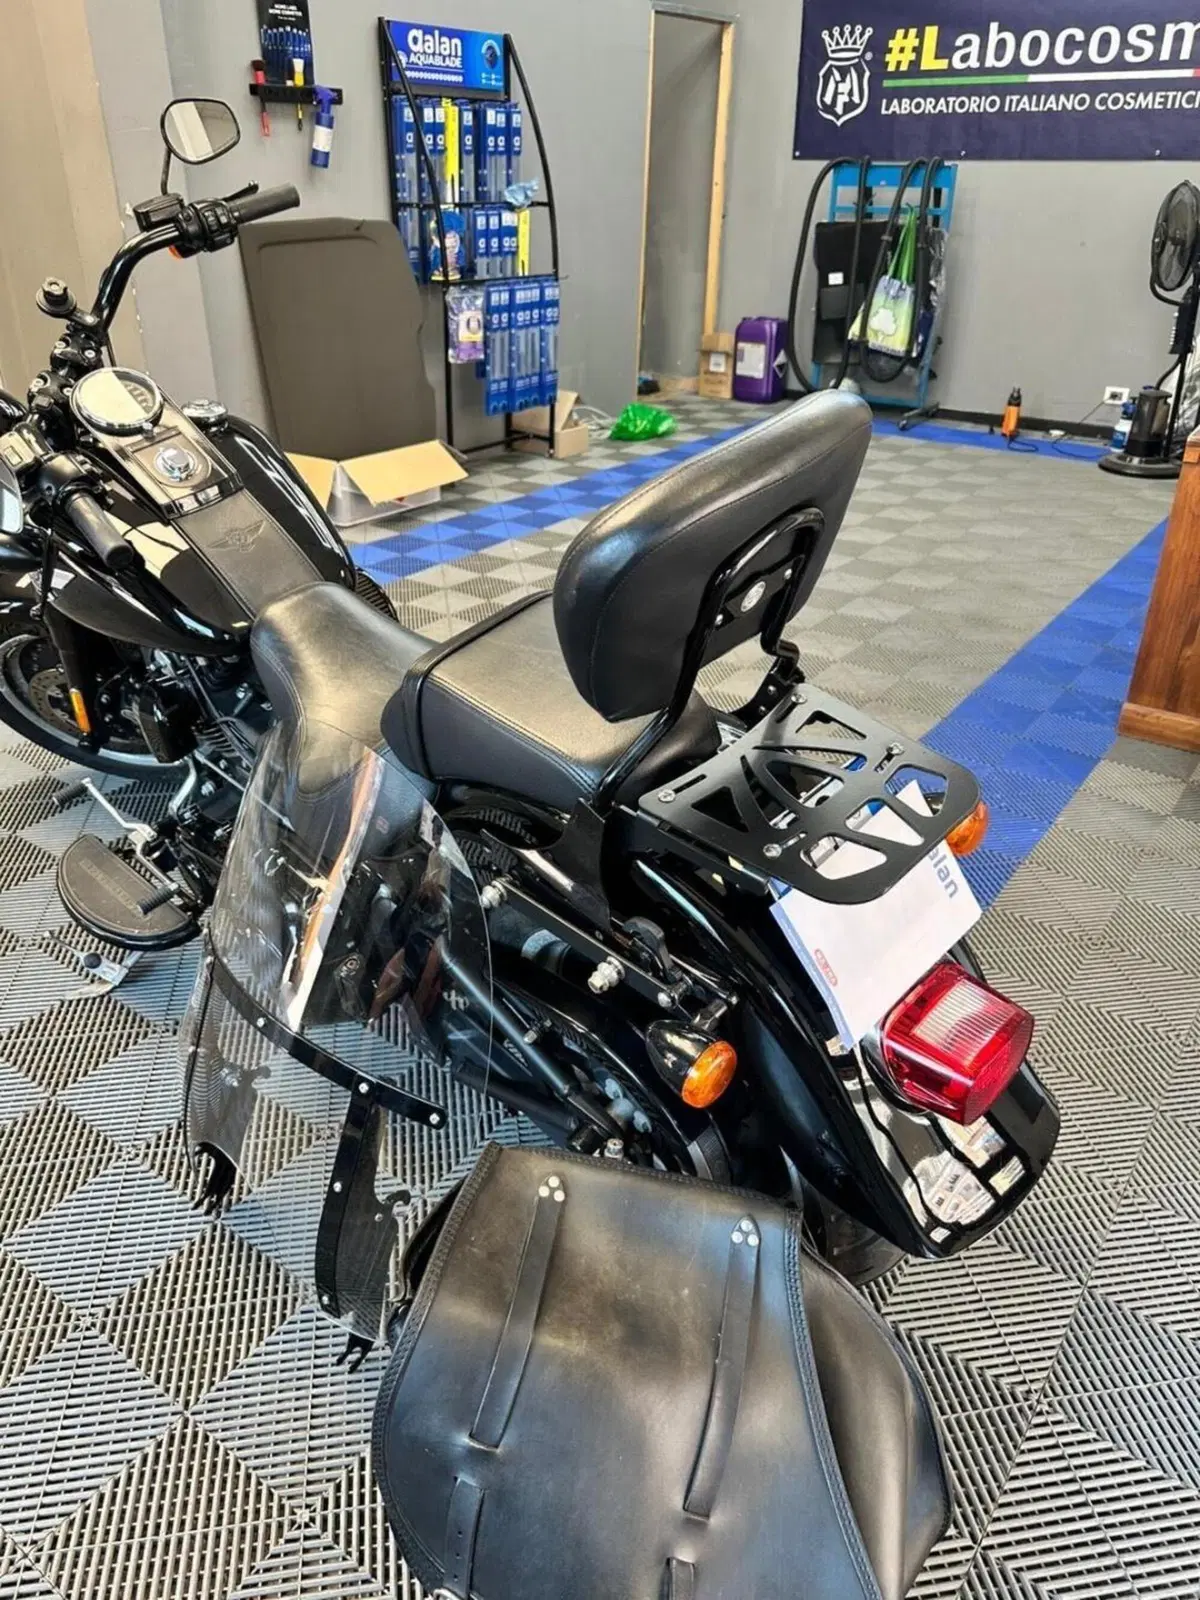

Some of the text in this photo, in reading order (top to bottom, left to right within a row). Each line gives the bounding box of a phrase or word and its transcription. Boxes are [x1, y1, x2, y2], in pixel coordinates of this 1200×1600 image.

[884, 20, 1200, 72] #Labocosm
[408, 53, 462, 68] AQUABLADE
[880, 90, 1200, 116] LABORATORIO ITALIANO COSMETICI
